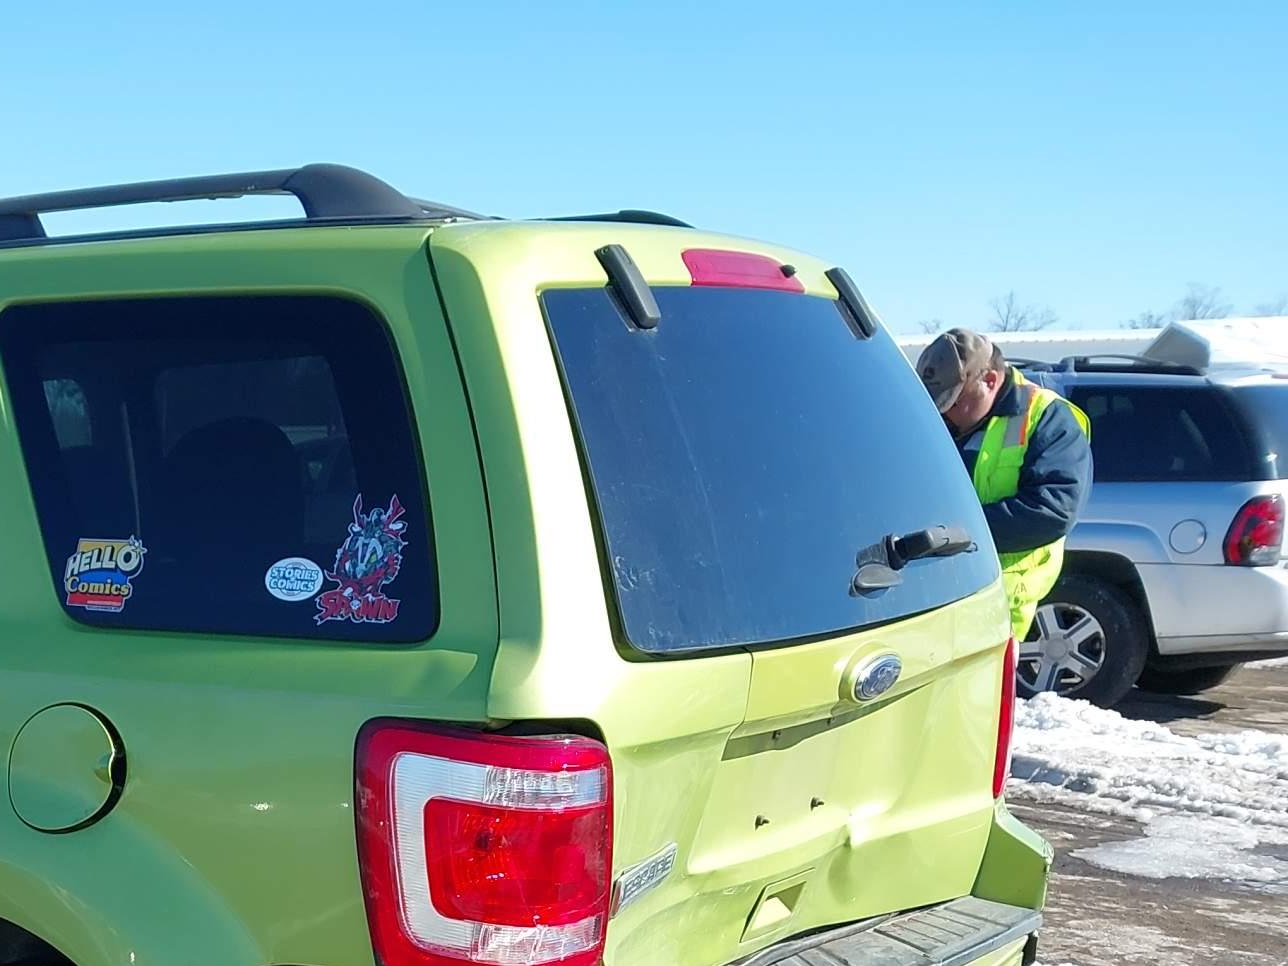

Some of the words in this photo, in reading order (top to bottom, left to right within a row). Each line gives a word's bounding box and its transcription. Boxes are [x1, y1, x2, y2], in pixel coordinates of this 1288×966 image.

[66, 544, 141, 578] HELLO
[271, 567, 319, 580] STORIES
[67, 576, 130, 596] Comics
[270, 578, 315, 592] COMICS
[622, 850, 675, 901] ESCAPE
